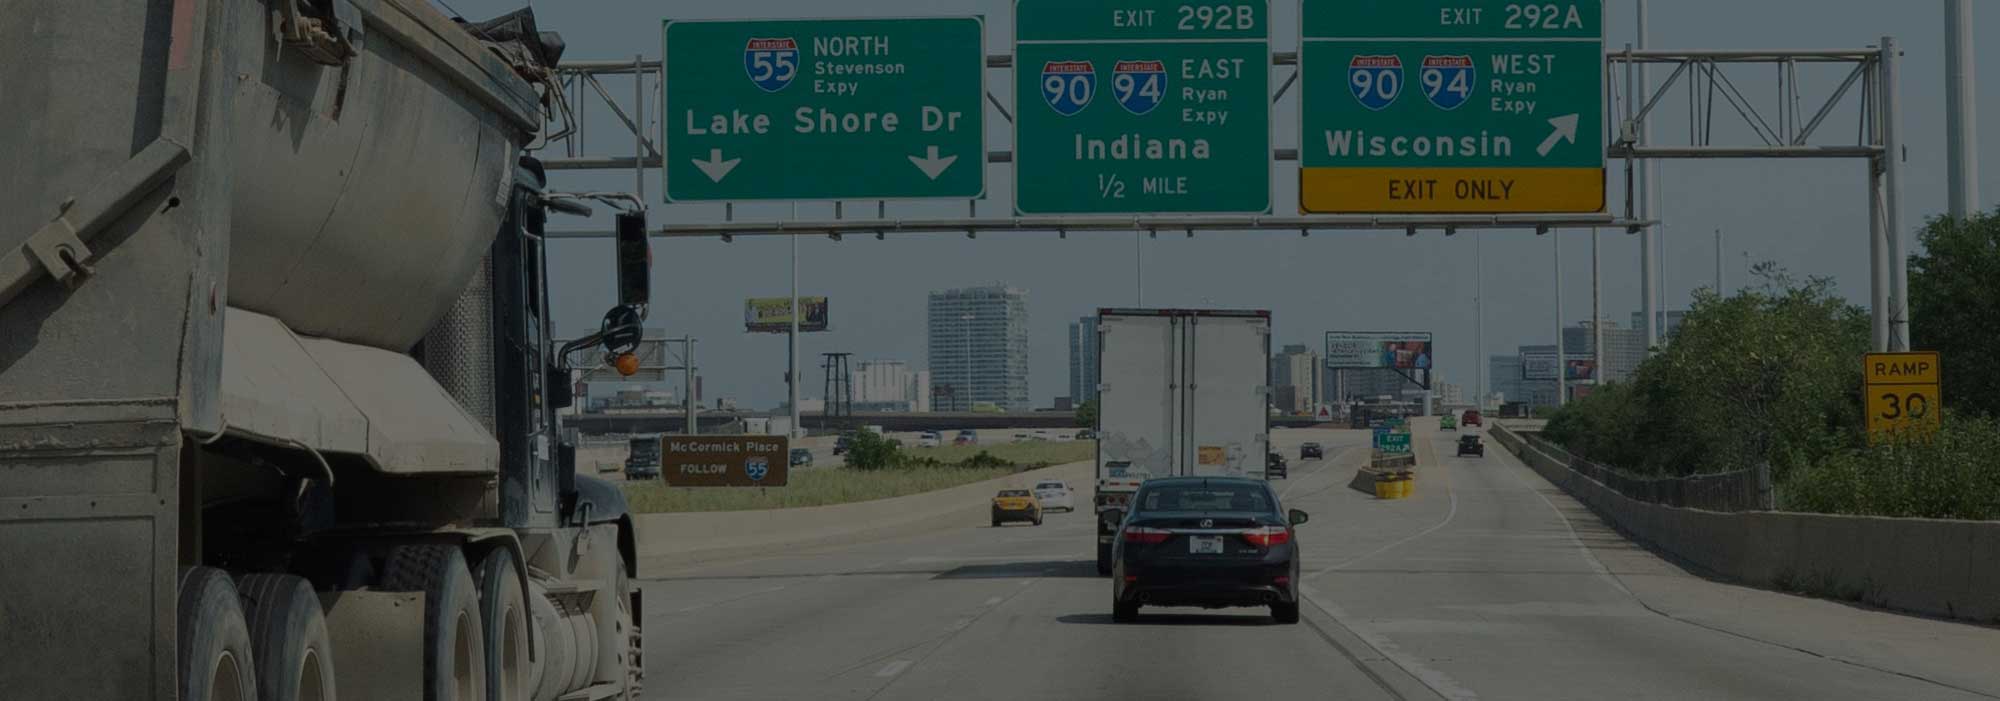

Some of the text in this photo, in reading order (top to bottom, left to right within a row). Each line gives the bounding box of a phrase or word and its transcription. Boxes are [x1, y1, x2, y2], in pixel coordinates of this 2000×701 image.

[1113, 5, 1254, 30] EXIT 292B
[1440, 4, 1583, 29] EXIT 292A
[813, 36, 889, 57] NORTH
[754, 51, 795, 81] 55
[815, 61, 905, 75] Stevenson
[1182, 59, 1244, 79] EAST
[1491, 54, 1555, 75] WEST
[814, 80, 858, 96] Expy
[1045, 74, 1160, 106] 90 94
[1352, 69, 1469, 100] 90 94
[1491, 79, 1536, 97] Ryan
[1182, 87, 1227, 105] Ryan
[1491, 97, 1536, 114] Expy
[687, 106, 962, 135] Lake Shore Dr
[1182, 108, 1228, 125] Expy
[1075, 133, 1211, 160] Indiana
[1325, 130, 1512, 157] Wisconsin
[1143, 177, 1188, 194] MILE
[1388, 179, 1515, 200] EXIT ONLY
[1874, 362, 1929, 376] RAMP
[1881, 392, 1928, 420] 30
[670, 441, 779, 453] McCormick Place
[1386, 435, 1404, 443] EXIT
[680, 462, 768, 475] FOLLOW 55
